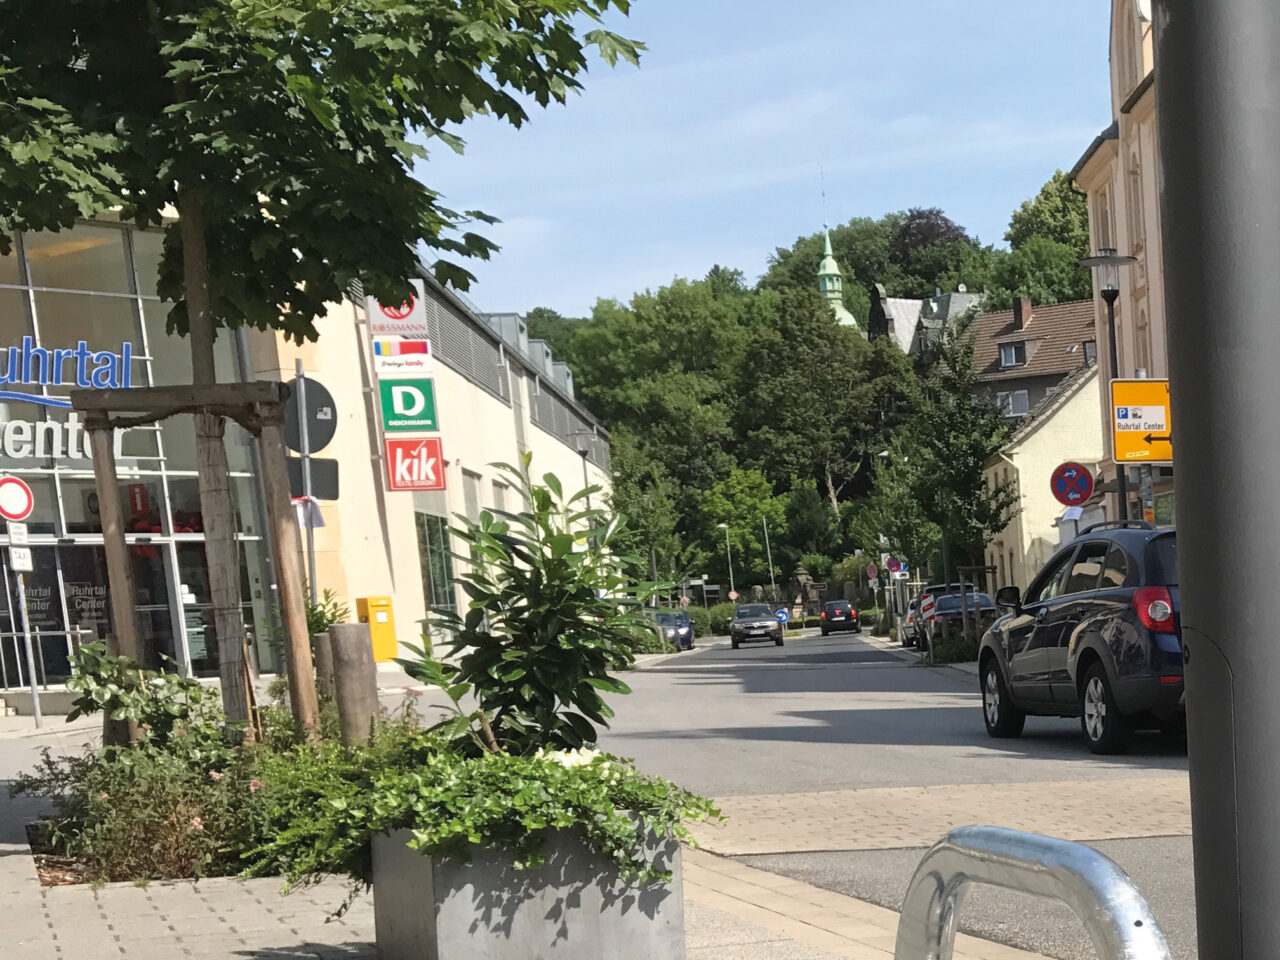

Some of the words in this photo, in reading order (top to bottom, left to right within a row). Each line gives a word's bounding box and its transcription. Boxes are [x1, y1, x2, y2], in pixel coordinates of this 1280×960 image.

[0, 336, 132, 389] uhrtal
[392, 385, 425, 416] D
[0, 412, 132, 459] entr
[1117, 422, 1141, 431] Ruhrtal
[1143, 422, 1164, 430] Center
[72, 584, 107, 596] Ruhrtal
[75, 598, 106, 609] Center
